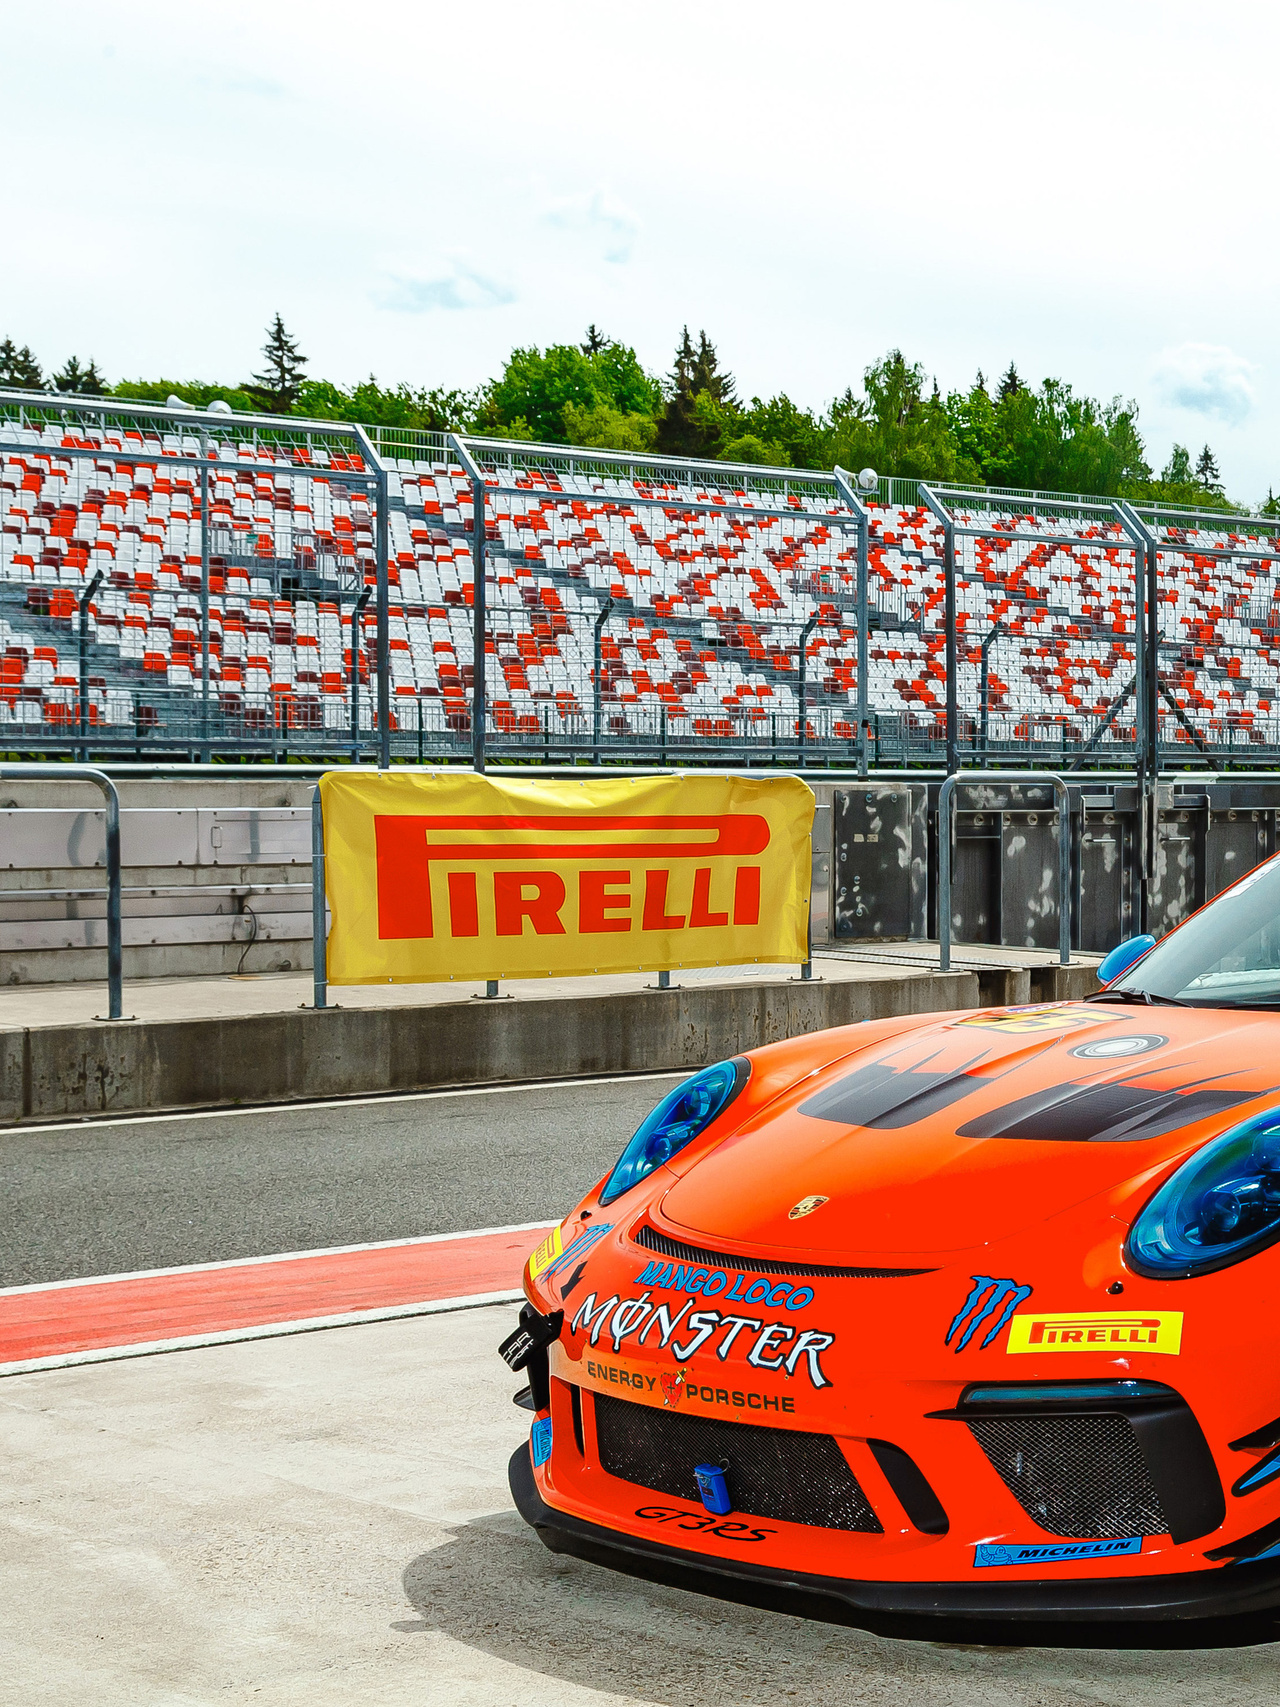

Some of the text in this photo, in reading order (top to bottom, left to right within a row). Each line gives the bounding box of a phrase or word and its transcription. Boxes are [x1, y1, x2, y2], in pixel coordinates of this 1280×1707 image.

[373, 814, 771, 940] PIRELLI
[634, 1261, 814, 1310] MANGO LOCO
[1028, 1319, 1161, 1344] PIRELLI
[587, 1361, 795, 1413] ENERGY PORSCHE
[1017, 1542, 1132, 1558] MICHELIN
